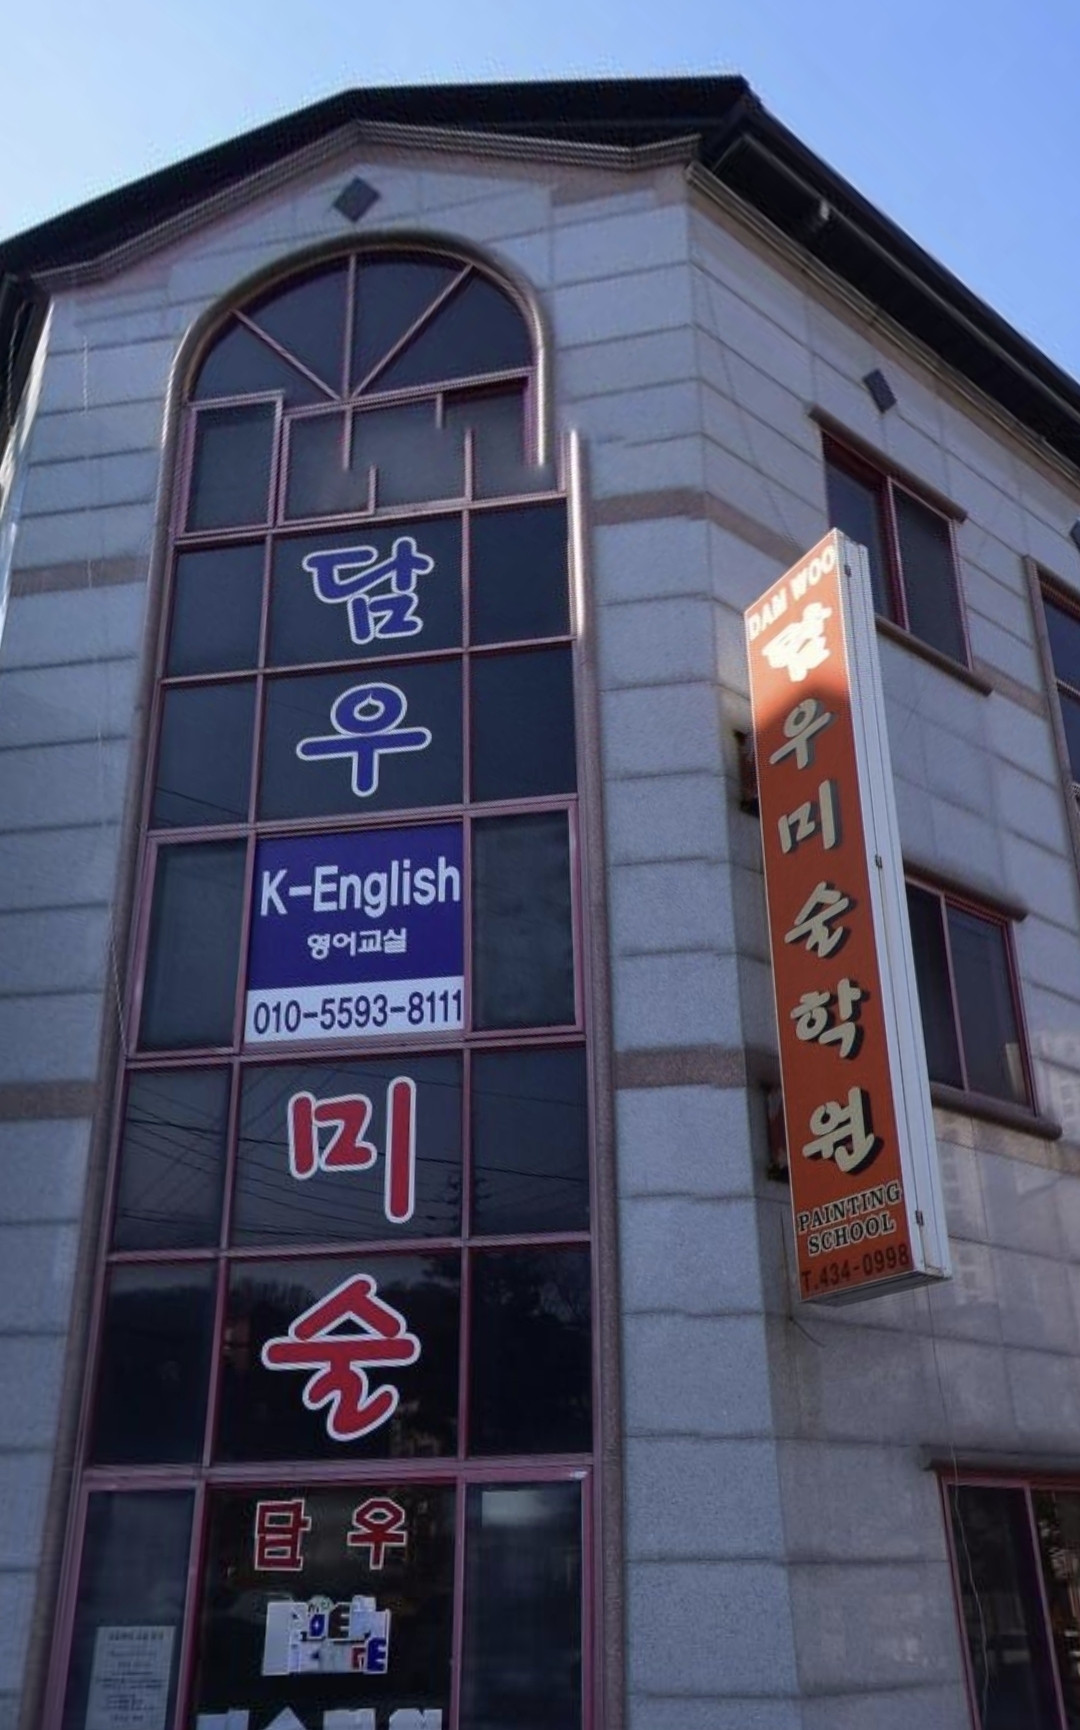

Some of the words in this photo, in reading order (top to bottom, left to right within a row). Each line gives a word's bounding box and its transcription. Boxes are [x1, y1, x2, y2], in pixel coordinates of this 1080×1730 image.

[260, 855, 461, 918] K-English
[307, 927, 408, 960] 영어교실
[253, 988, 462, 1035] 010-5593-8111
[798, 1179, 902, 1236] PAINTING
[808, 1211, 897, 1257] SCHOOL
